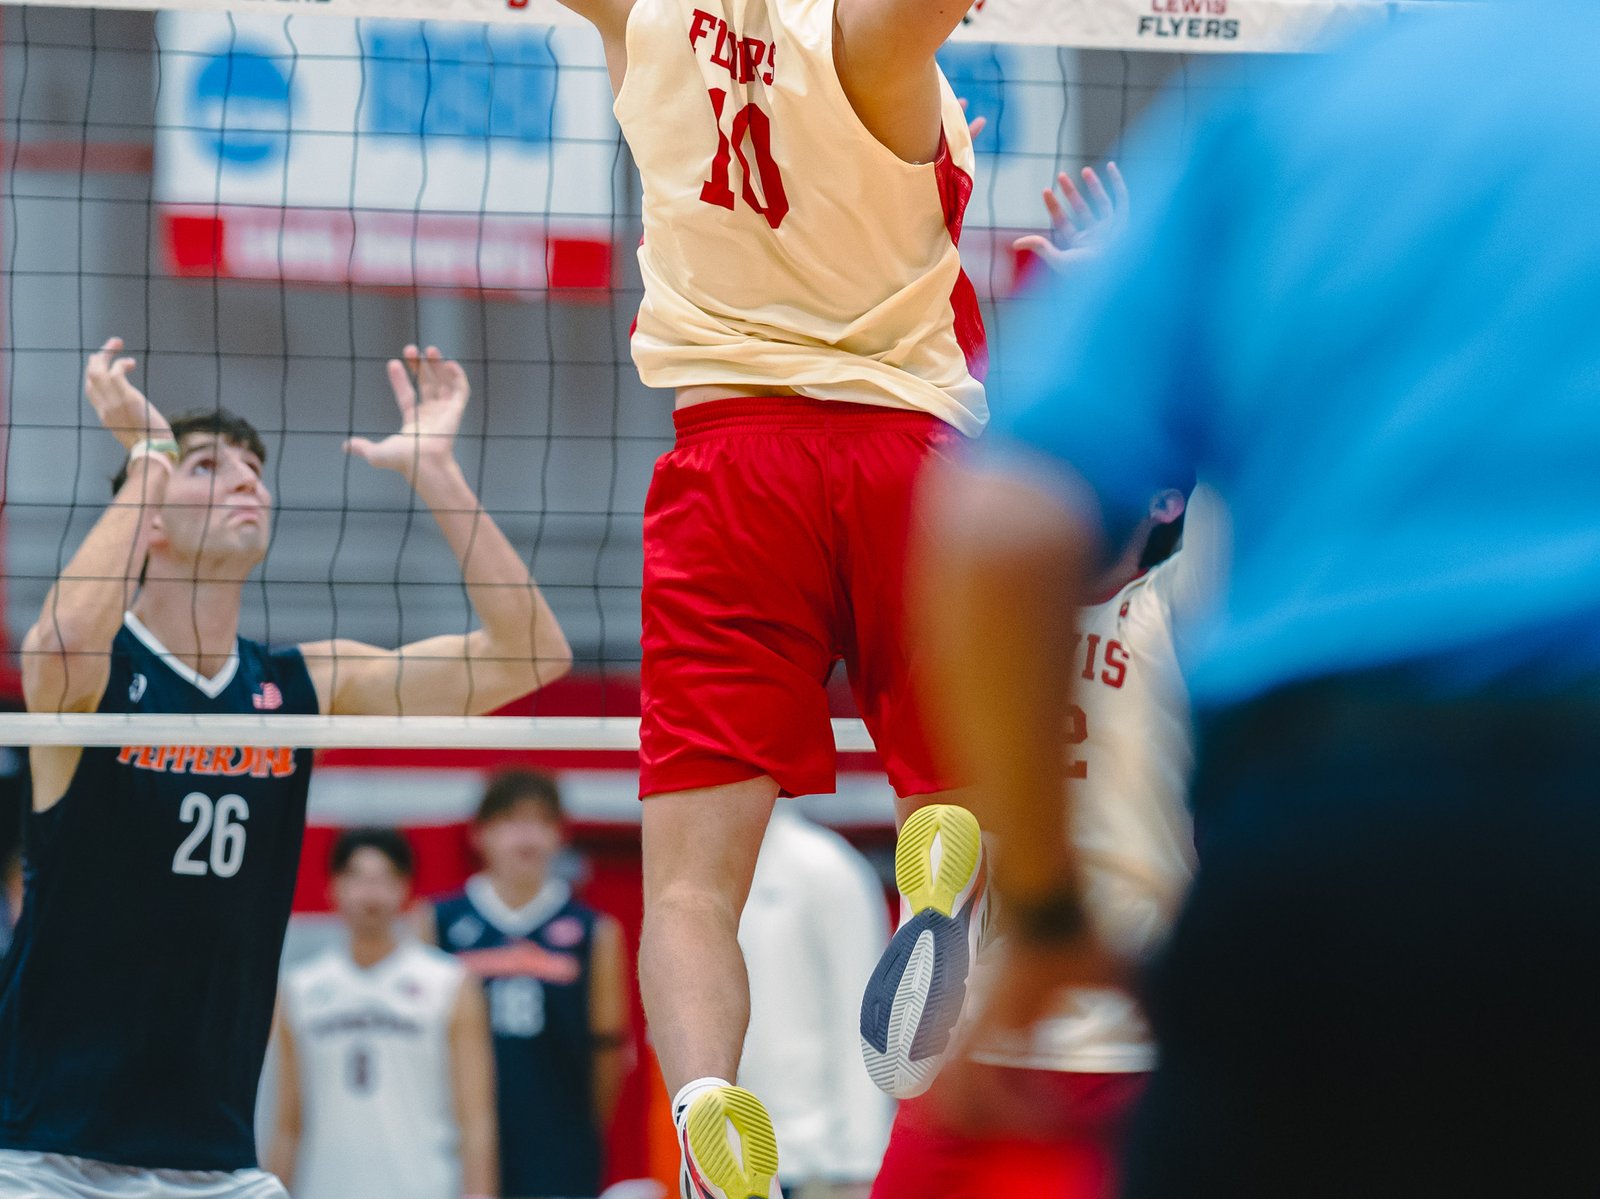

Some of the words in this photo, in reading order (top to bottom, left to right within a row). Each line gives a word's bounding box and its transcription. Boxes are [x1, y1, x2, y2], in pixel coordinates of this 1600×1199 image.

[1138, 16, 1239, 38] FLYERS
[699, 87, 790, 229] 10
[172, 791, 250, 879] 26
